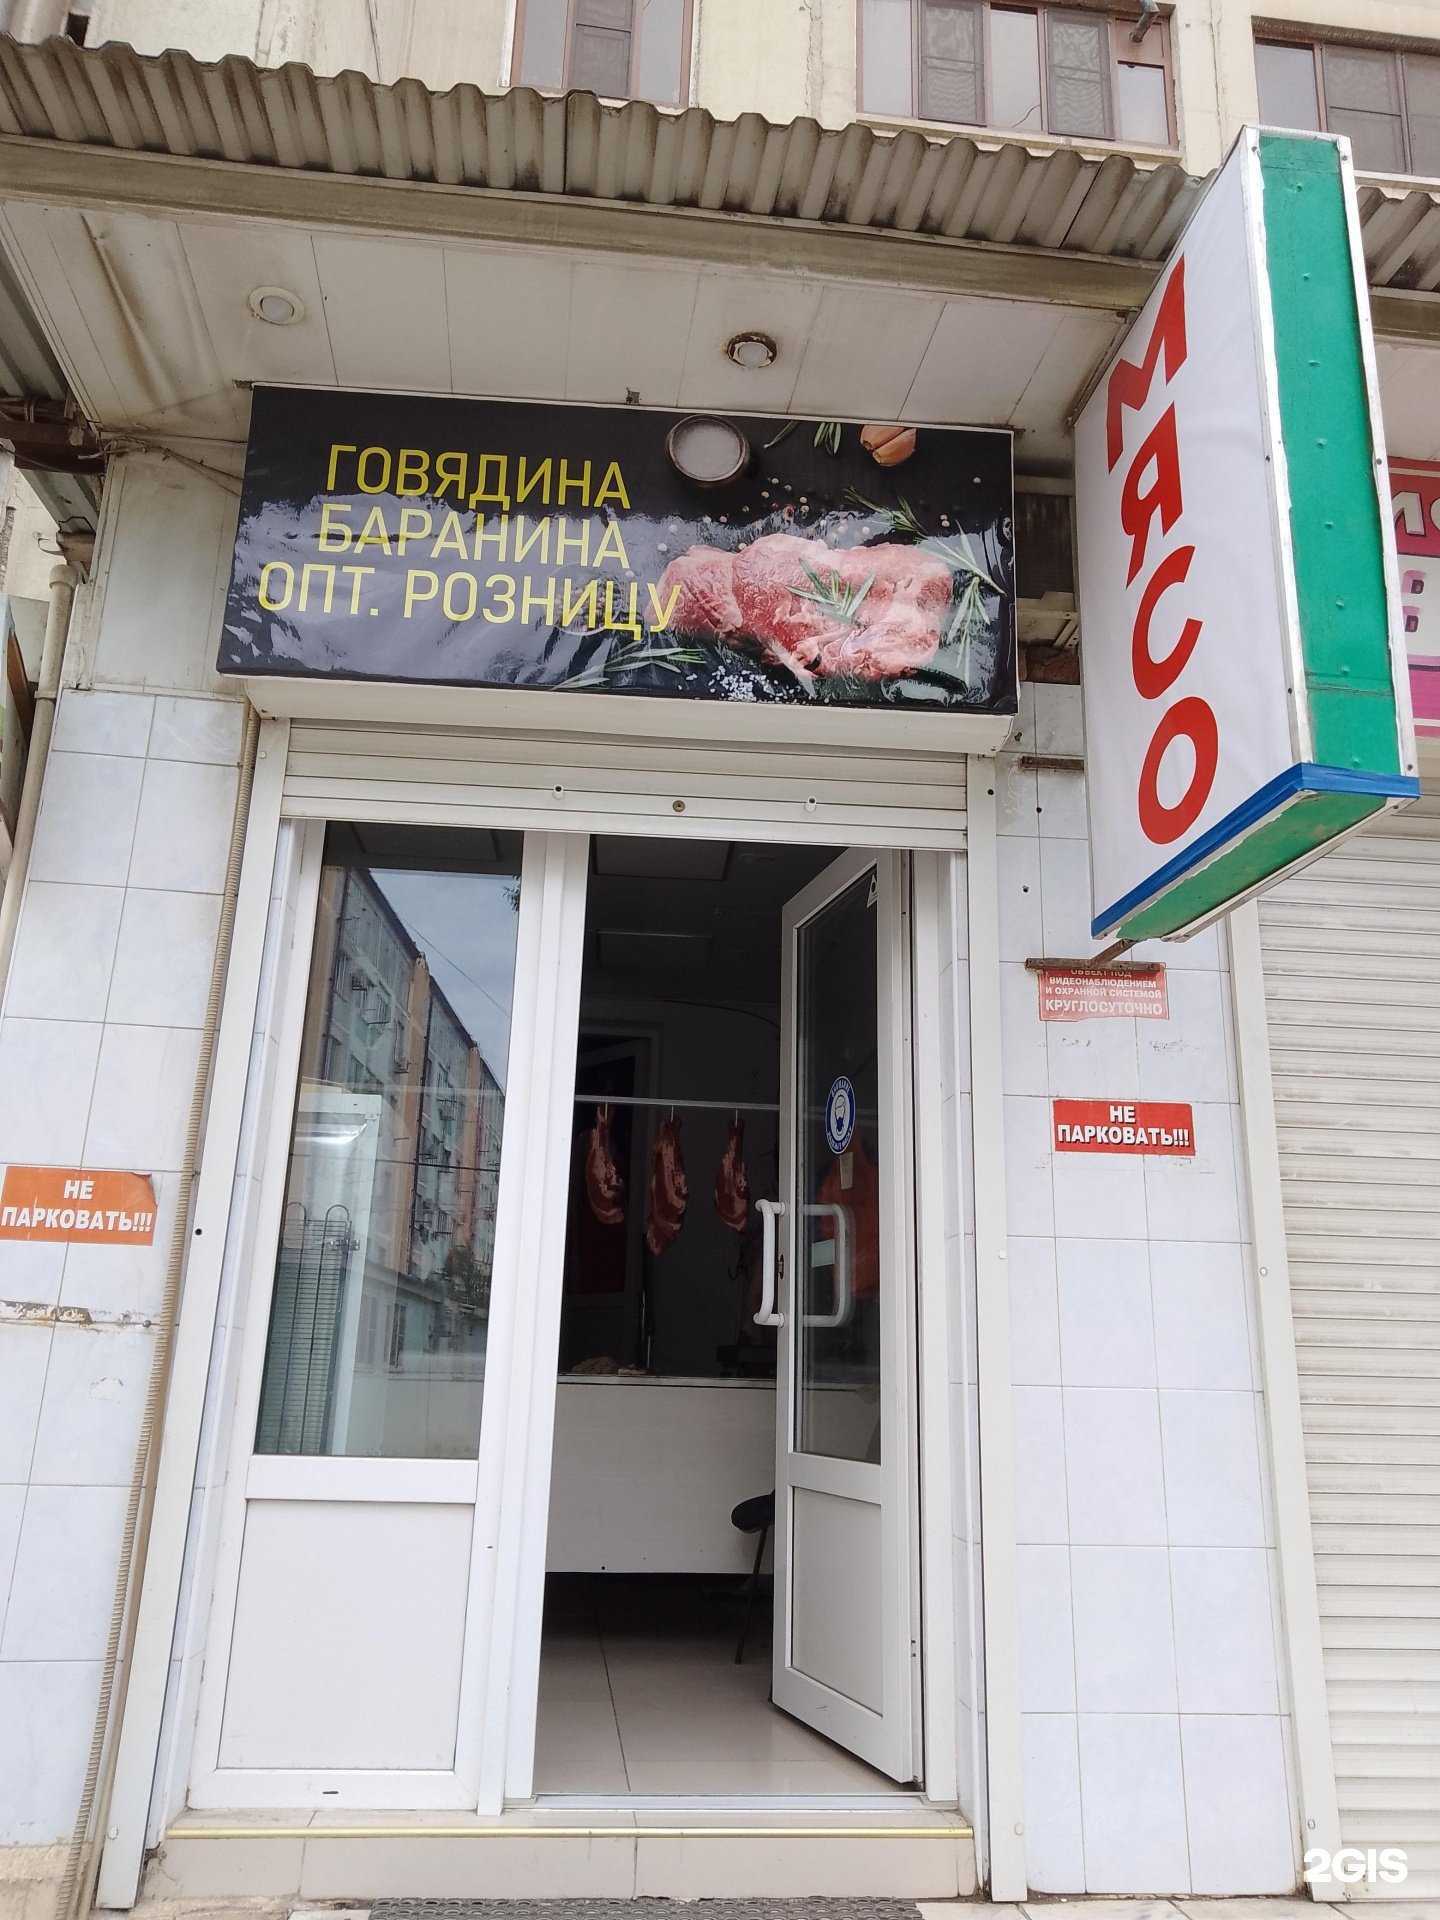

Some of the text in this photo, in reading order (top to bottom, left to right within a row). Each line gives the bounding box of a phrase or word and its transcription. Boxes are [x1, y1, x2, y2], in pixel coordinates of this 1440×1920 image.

[326, 444, 631, 510] ГОВЯДИНА
[318, 503, 631, 569] БАРАНИНА
[1106, 254, 1219, 844] МЯСО
[259, 561, 682, 641] ОПТ. РОЗНИЦУ
[1045, 986, 1052, 994] И
[1049, 977, 1157, 989] ВИДЕОНАБЛЮДЕНИЕМ
[1045, 999, 1163, 1015] КРУГЛОСУТОЧНО
[1109, 1105, 1136, 1123] НЕ
[1057, 1124, 1190, 1146] ПАРКОВАТЬ!!!
[63, 1179, 96, 1200] НЕ
[0, 1206, 153, 1232] ПАРКОВАТЬ!!!
